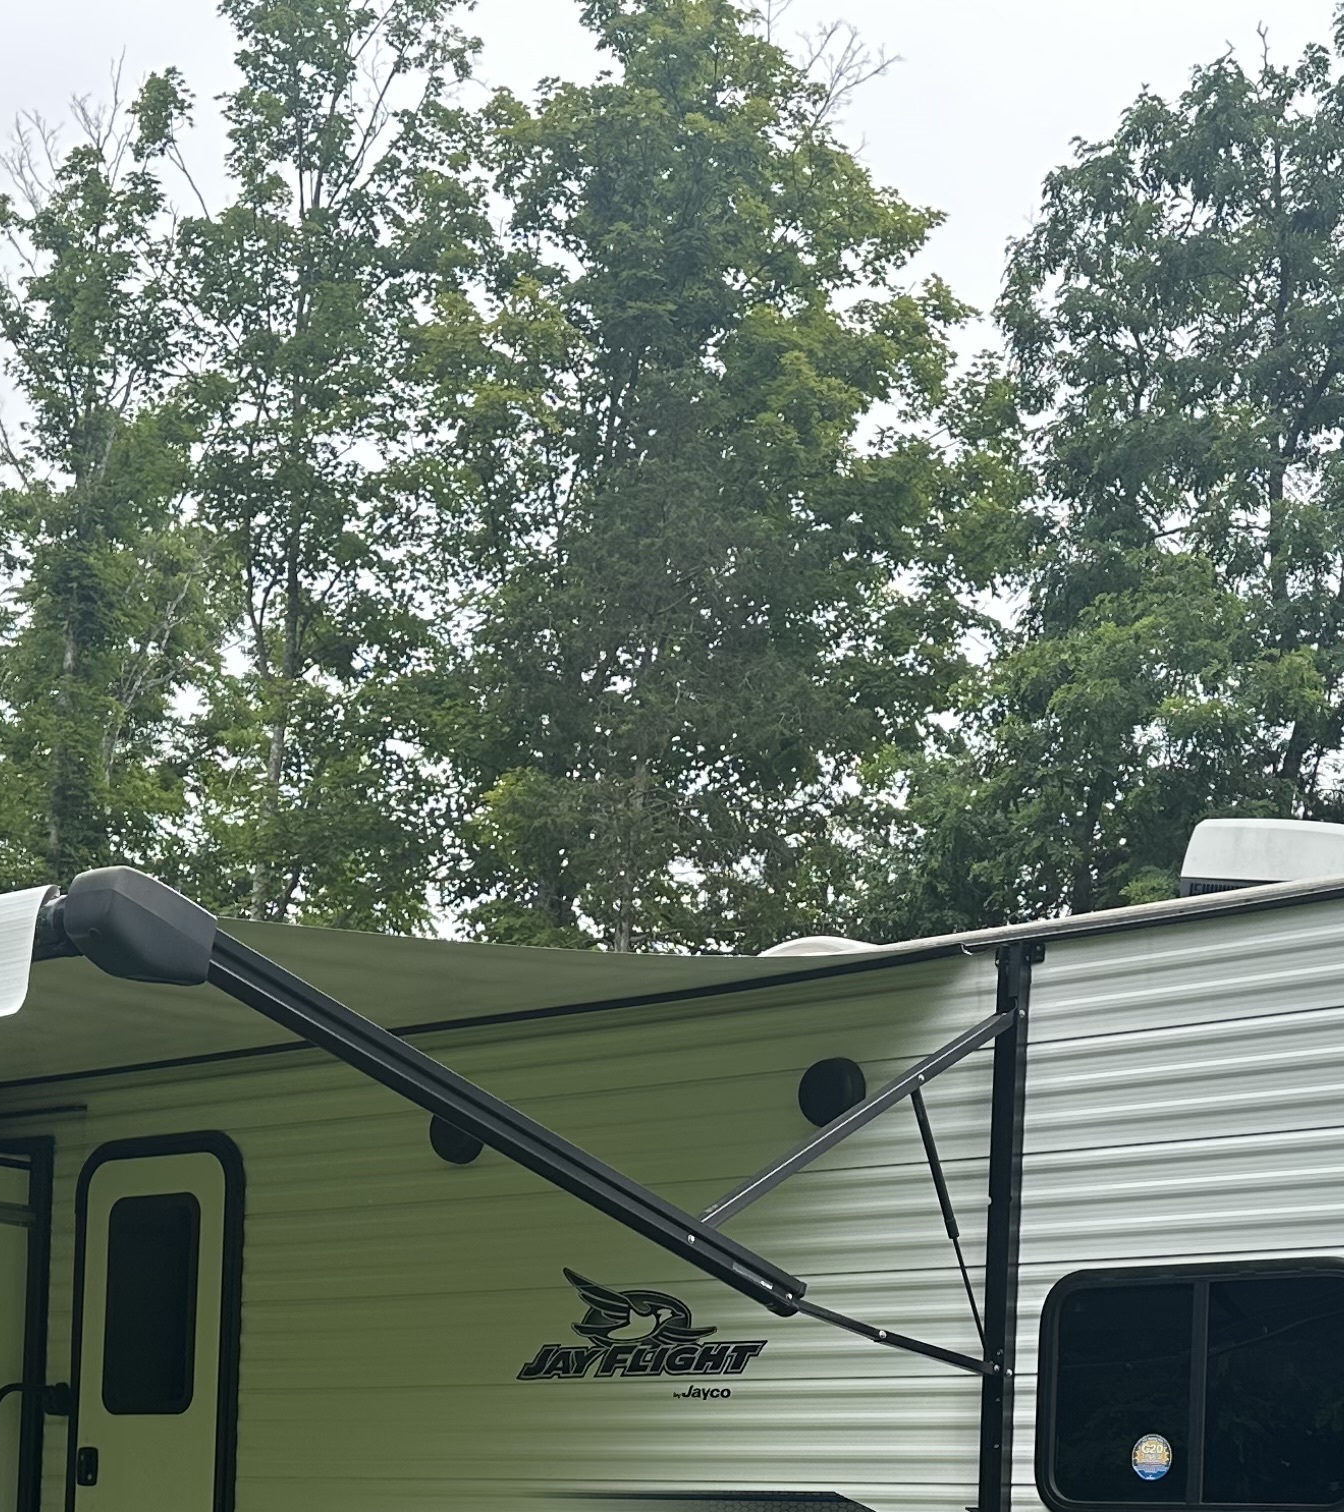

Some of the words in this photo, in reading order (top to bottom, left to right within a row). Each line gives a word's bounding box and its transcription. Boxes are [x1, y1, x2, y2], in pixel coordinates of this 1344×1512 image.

[516, 1344, 602, 1380] JAY
[594, 1340, 768, 1378] FLIGHT
[681, 1384, 731, 1401] Jayco
